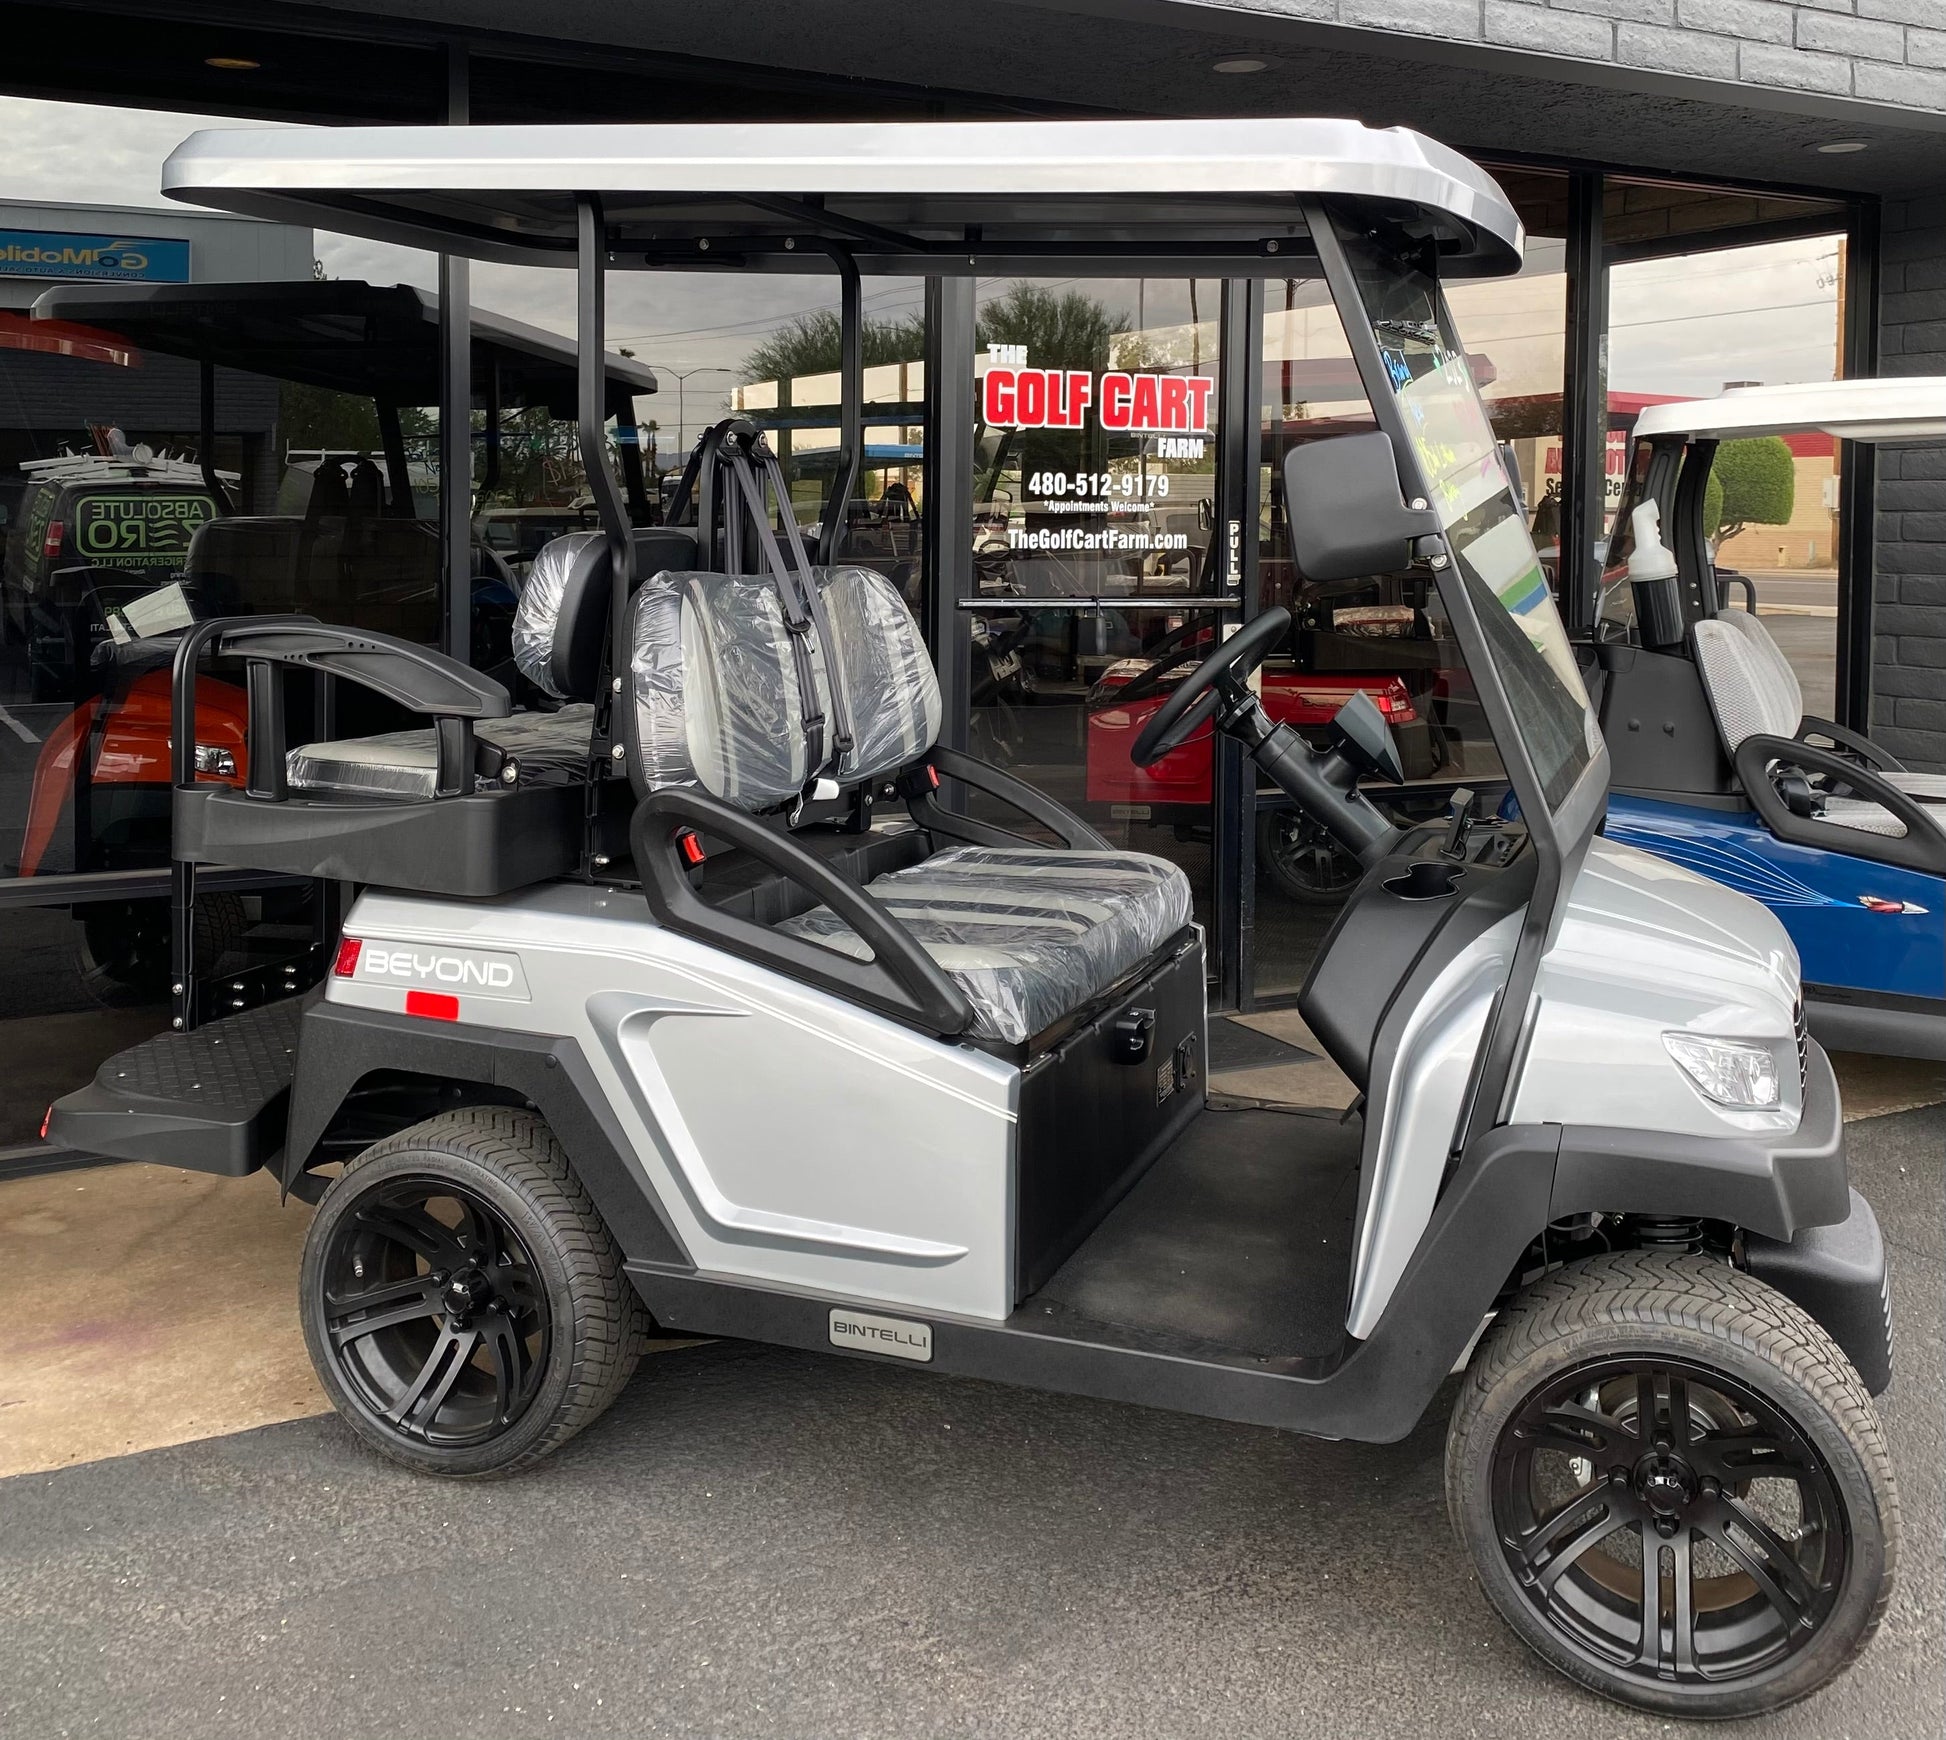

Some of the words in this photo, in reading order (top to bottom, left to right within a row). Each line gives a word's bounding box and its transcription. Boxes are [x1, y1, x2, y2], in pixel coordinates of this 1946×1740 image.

[987, 343, 1028, 364] THE
[983, 367, 1092, 429] GOLF
[1100, 372, 1214, 432] CART
[1158, 437, 1205, 459] FARM
[1028, 472, 1169, 497] 480-512-9179
[1008, 528, 1188, 550] TheGolfCartFarm.com
[1229, 523, 1239, 575] PULL
[365, 949, 514, 988] BEYOND
[833, 1321, 927, 1348] BINTELLI
